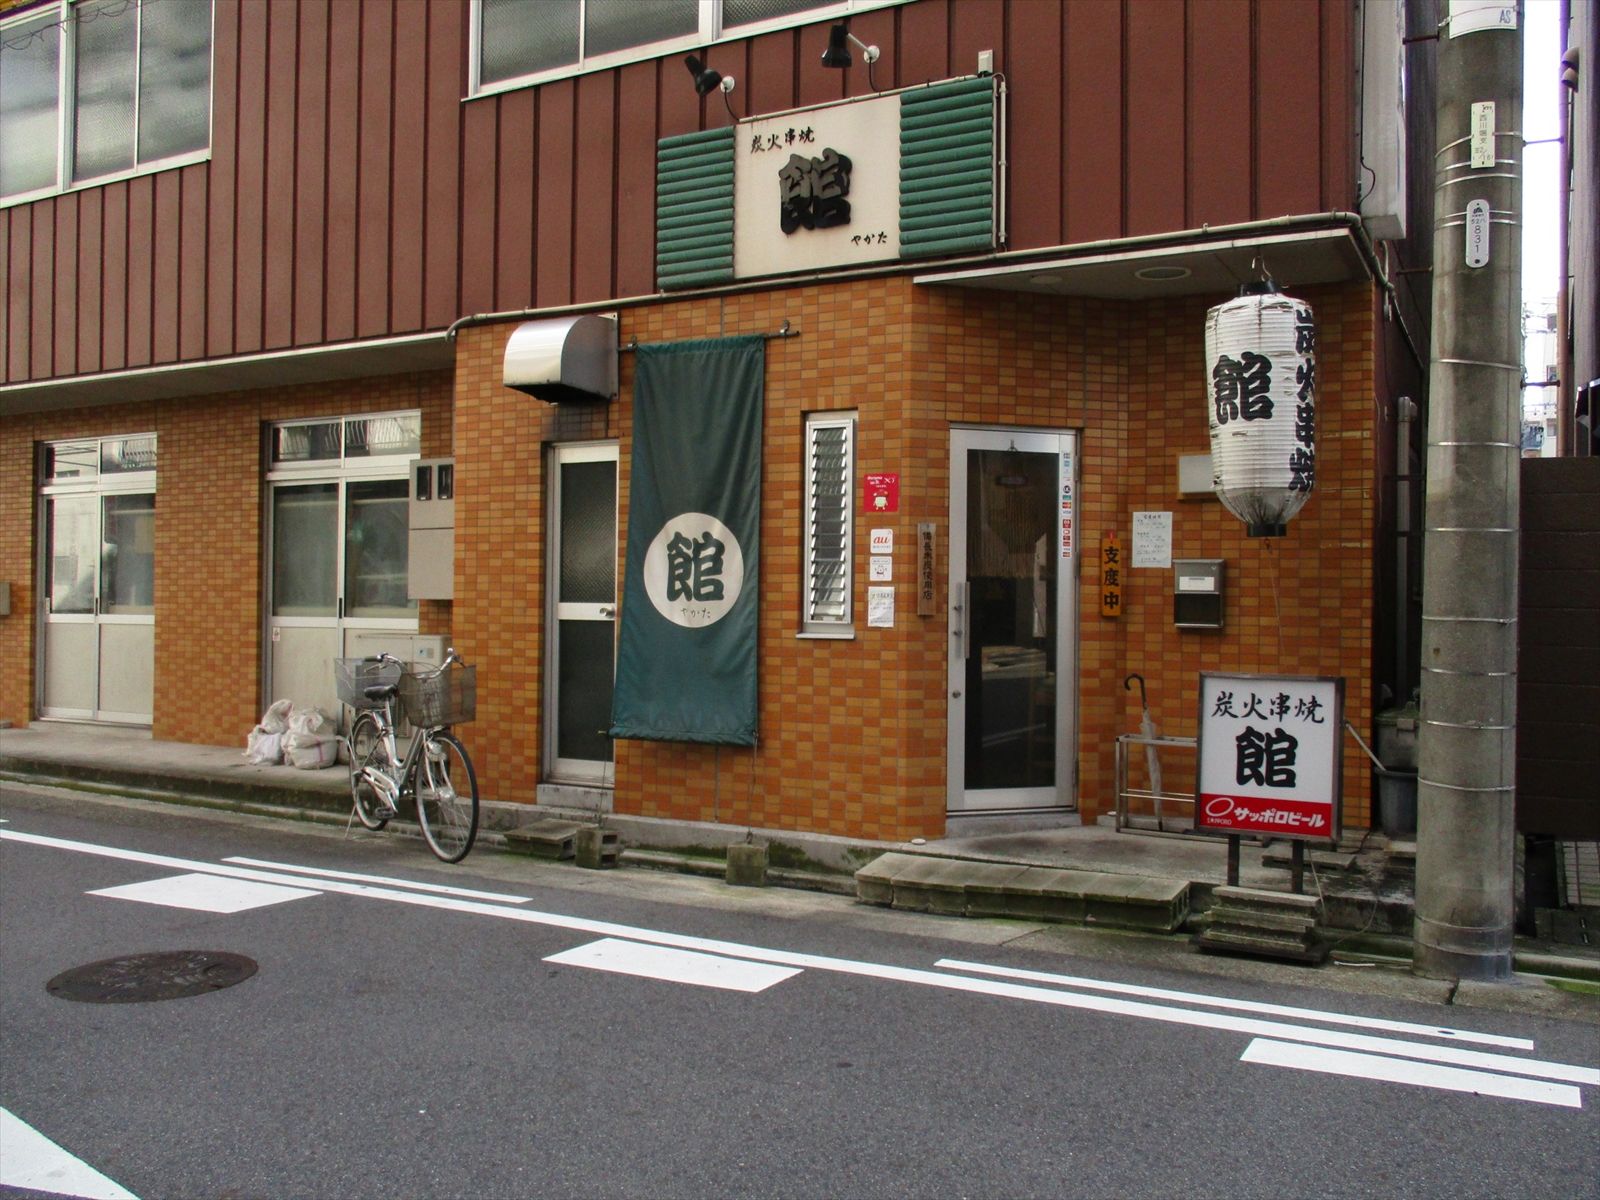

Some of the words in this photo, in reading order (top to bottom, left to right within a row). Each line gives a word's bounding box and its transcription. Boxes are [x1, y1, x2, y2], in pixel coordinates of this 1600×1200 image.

[1499, 9, 1511, 24] AS
[750, 126, 816, 154] 炭火串焼
[779, 147, 853, 235] 館
[851, 231, 888, 247] やかた
[1474, 225, 1482, 253] 831
[1213, 351, 1274, 425] 館
[873, 536, 889, 544] au
[667, 531, 726, 602] 館
[1104, 546, 1120, 609] 支度中
[680, 607, 711, 619] やかた
[1211, 690, 1325, 724] 炭火串焼
[1235, 725, 1299, 788] 館
[1233, 807, 1326, 828] サッポロビール
